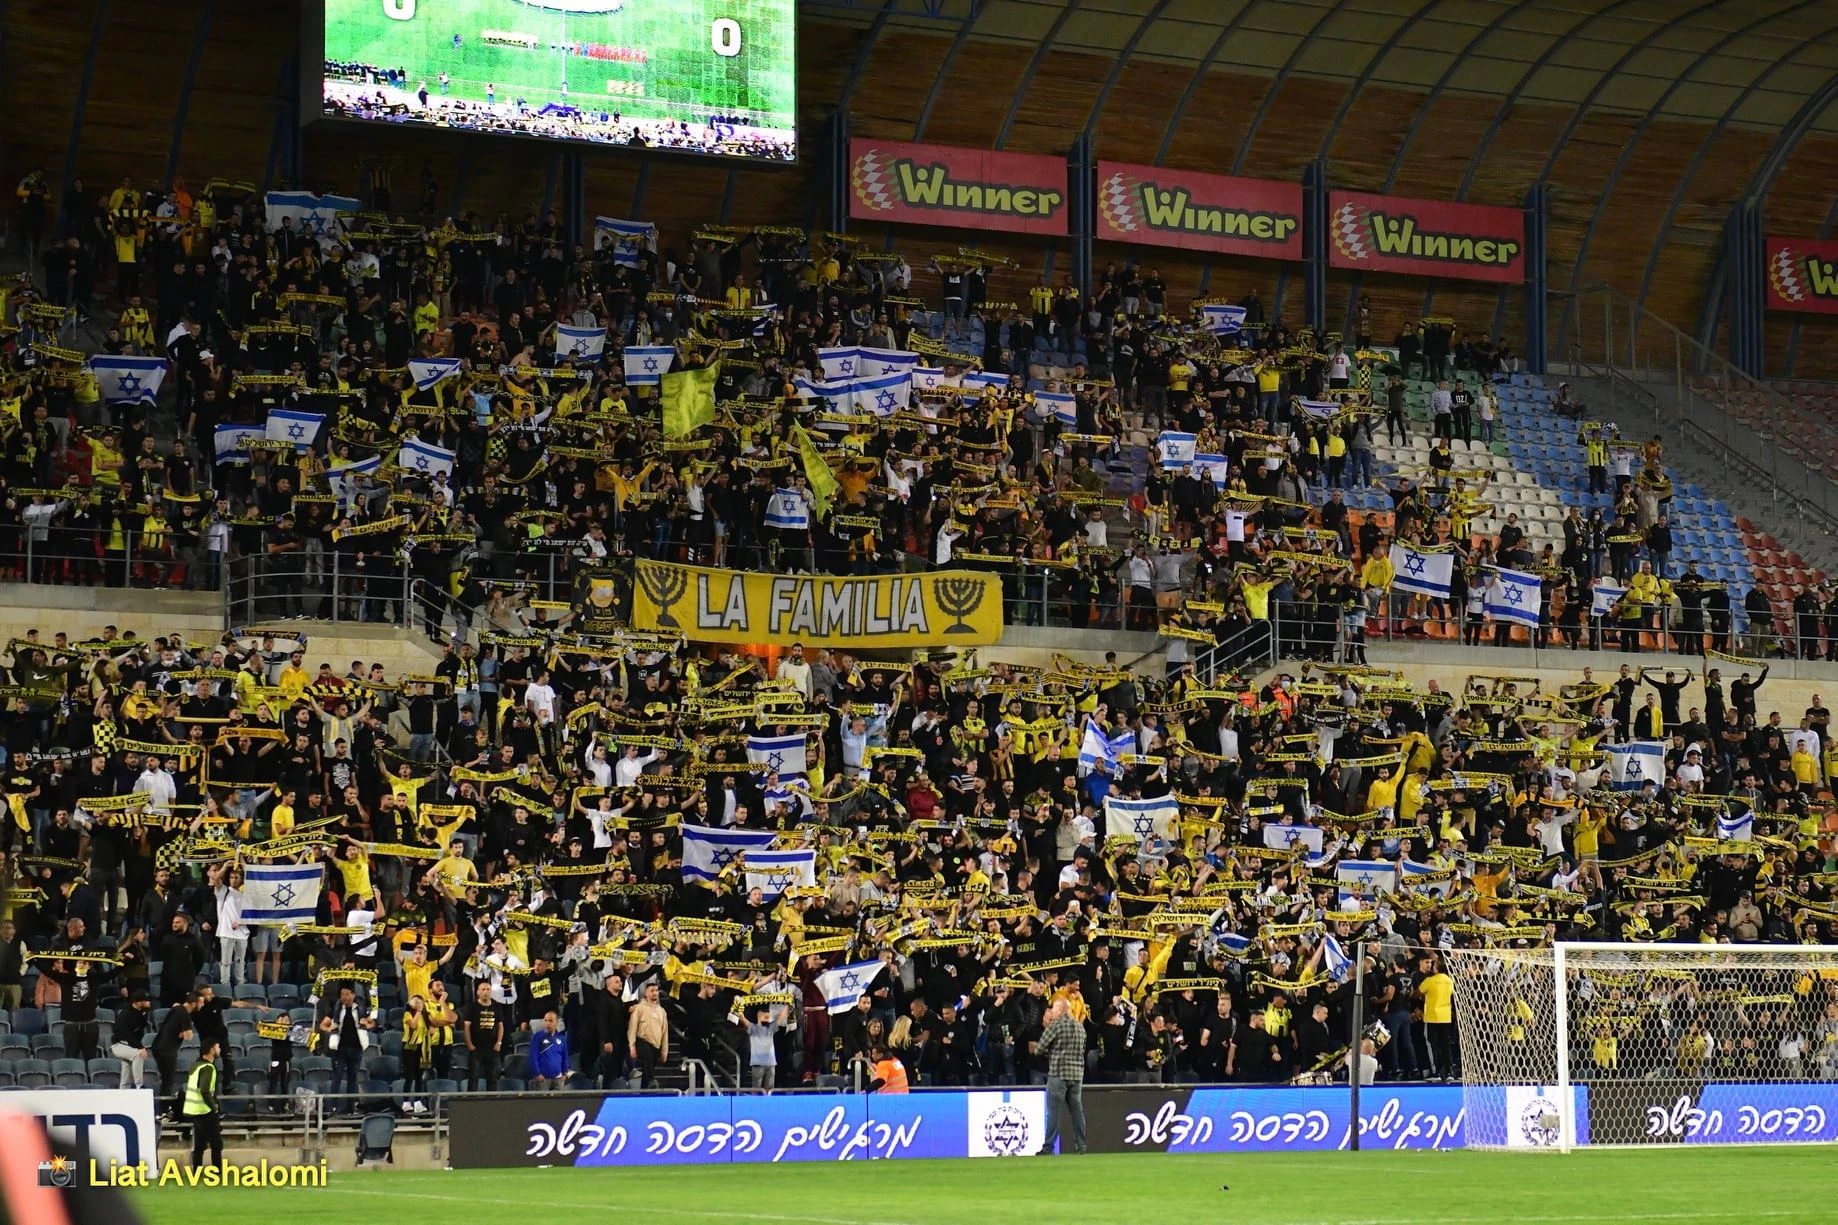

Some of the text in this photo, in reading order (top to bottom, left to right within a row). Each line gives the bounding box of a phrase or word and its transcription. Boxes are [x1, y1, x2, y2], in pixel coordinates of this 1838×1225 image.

[711, 17, 742, 56] 0
[897, 161, 1060, 218] Winner
[1140, 183, 1297, 242] Winner
[1372, 215, 1517, 265] Winner
[697, 574, 930, 637] LA FAMILIA
[526, 1106, 922, 1162] מרגישים הדסה חדשה
[1124, 1101, 1214, 1145] חדשה
[1229, 1110, 1330, 1143] הדסה
[1647, 1096, 1826, 1136] הדסה חדשה
